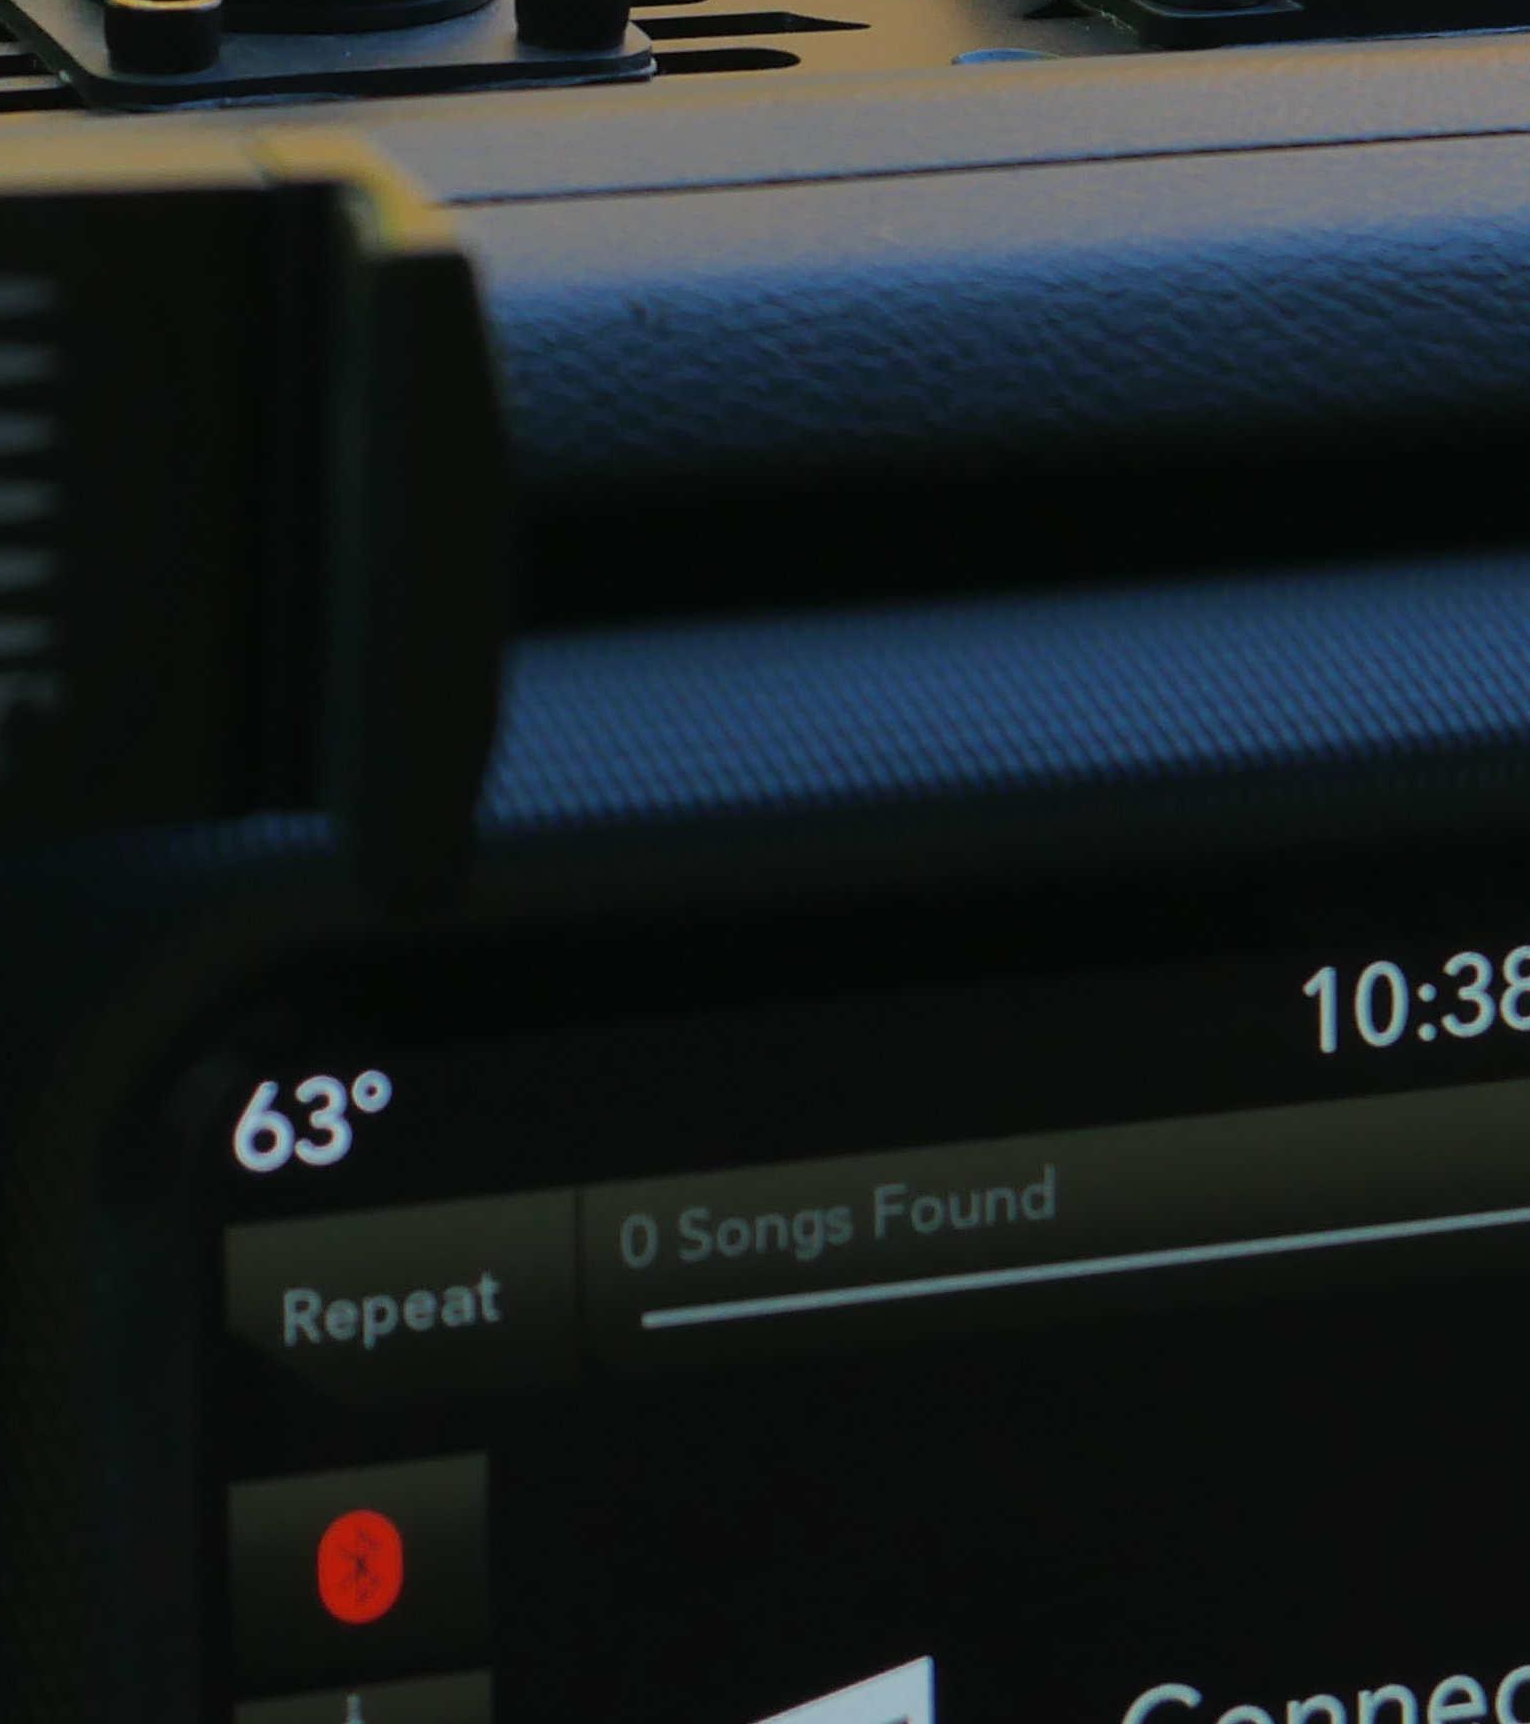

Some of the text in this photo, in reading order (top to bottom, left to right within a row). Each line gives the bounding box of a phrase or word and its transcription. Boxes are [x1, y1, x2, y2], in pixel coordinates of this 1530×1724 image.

[232, 1070, 393, 1172] 63°
[620, 1164, 1057, 1268] 0 Songs Found
[283, 1272, 501, 1349] Repeat
